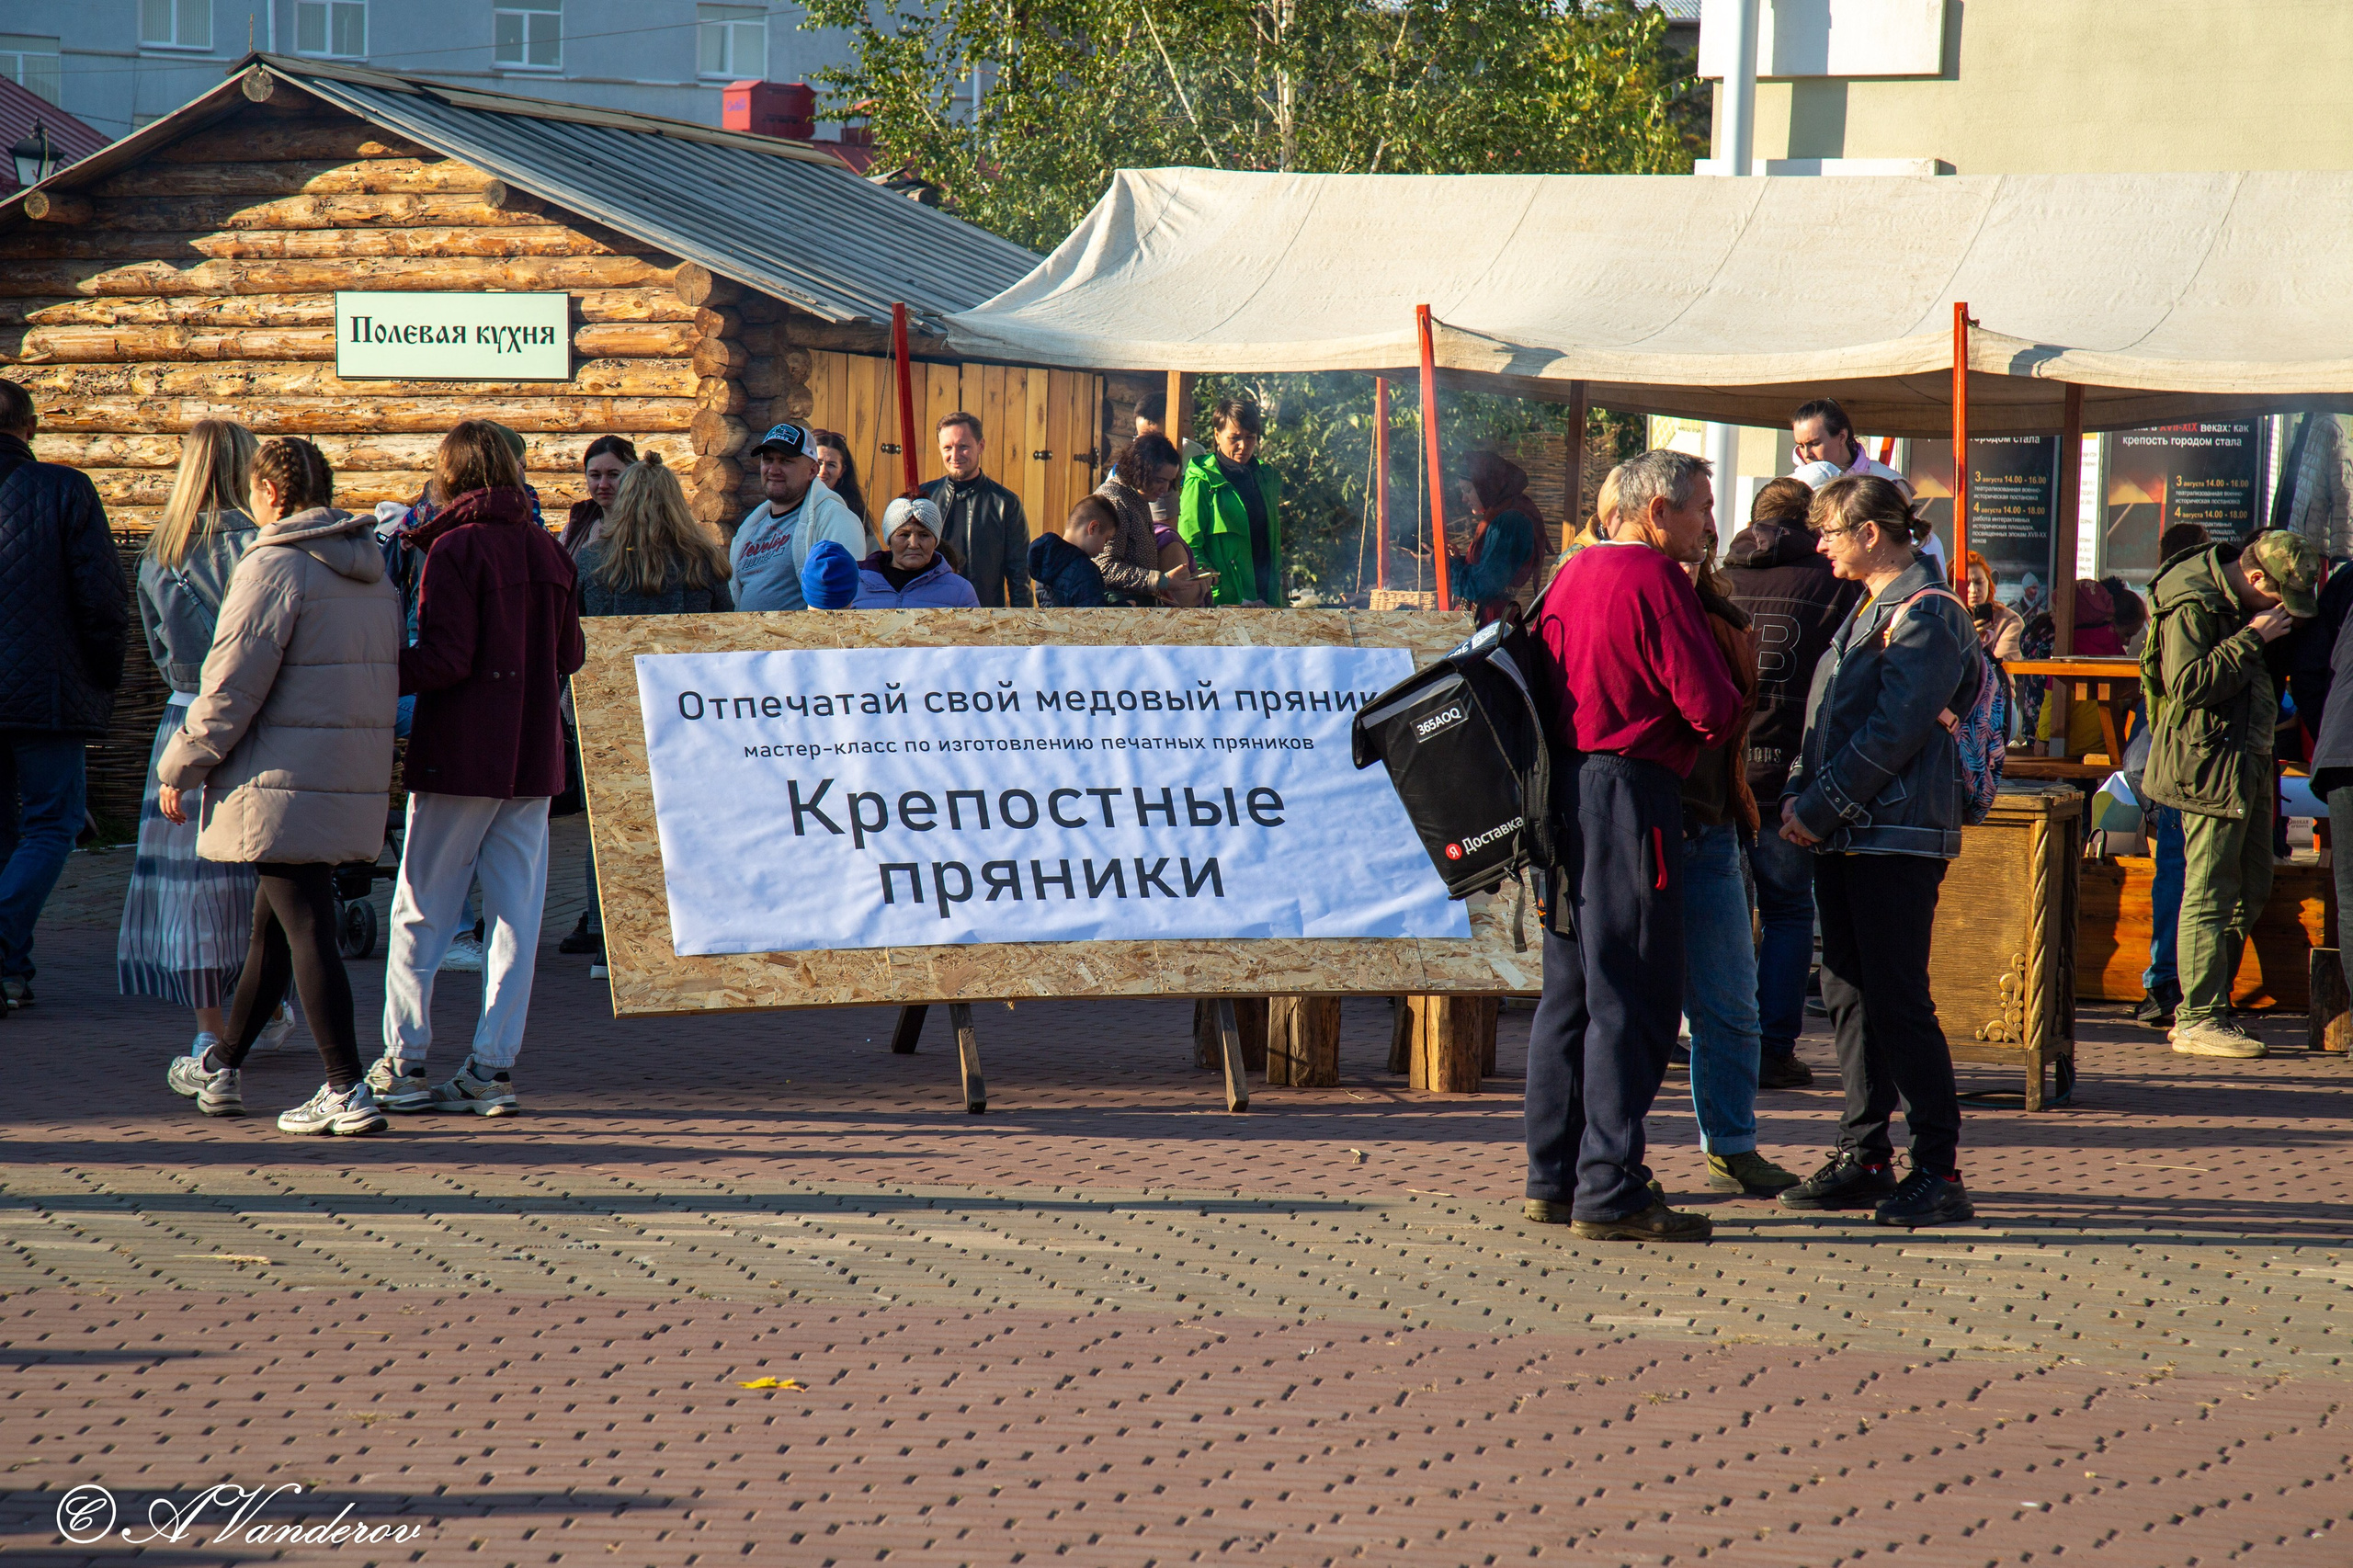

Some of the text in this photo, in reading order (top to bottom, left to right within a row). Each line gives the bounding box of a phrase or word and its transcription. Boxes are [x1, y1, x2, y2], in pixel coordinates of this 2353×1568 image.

[350, 316, 555, 354] Полевая кухня
[2200, 423, 2231, 433] веках:
[2234, 424, 2249, 433] как
[2122, 436, 2243, 448] крепость городом стала
[1974, 471, 1982, 483] 3
[2005, 475, 2022, 483] 14.00
[2029, 476, 2047, 484] 16.00
[2176, 474, 2183, 487] 3
[2206, 479, 2224, 487] 14.00
[2231, 479, 2249, 488] 16.00
[1973, 501, 1981, 513] 4
[2003, 506, 2021, 514] 14.00
[2028, 506, 2046, 515] 18.00
[2174, 506, 2181, 517] 4
[2204, 510, 2223, 518] 14.00
[2229, 510, 2248, 518] 18.00
[1753, 613, 1801, 682] B
[677, 682, 908, 721] Отпечатай
[924, 680, 1020, 712] свой
[1036, 680, 1221, 716] медовый
[1415, 707, 1461, 736] 365AOQ
[744, 736, 1314, 760] мастер-класс по изготовлению печатных пряников
[787, 778, 1286, 849] Крепостные
[1447, 816, 1524, 859] Я Доставка
[879, 857, 1224, 919] пряники
